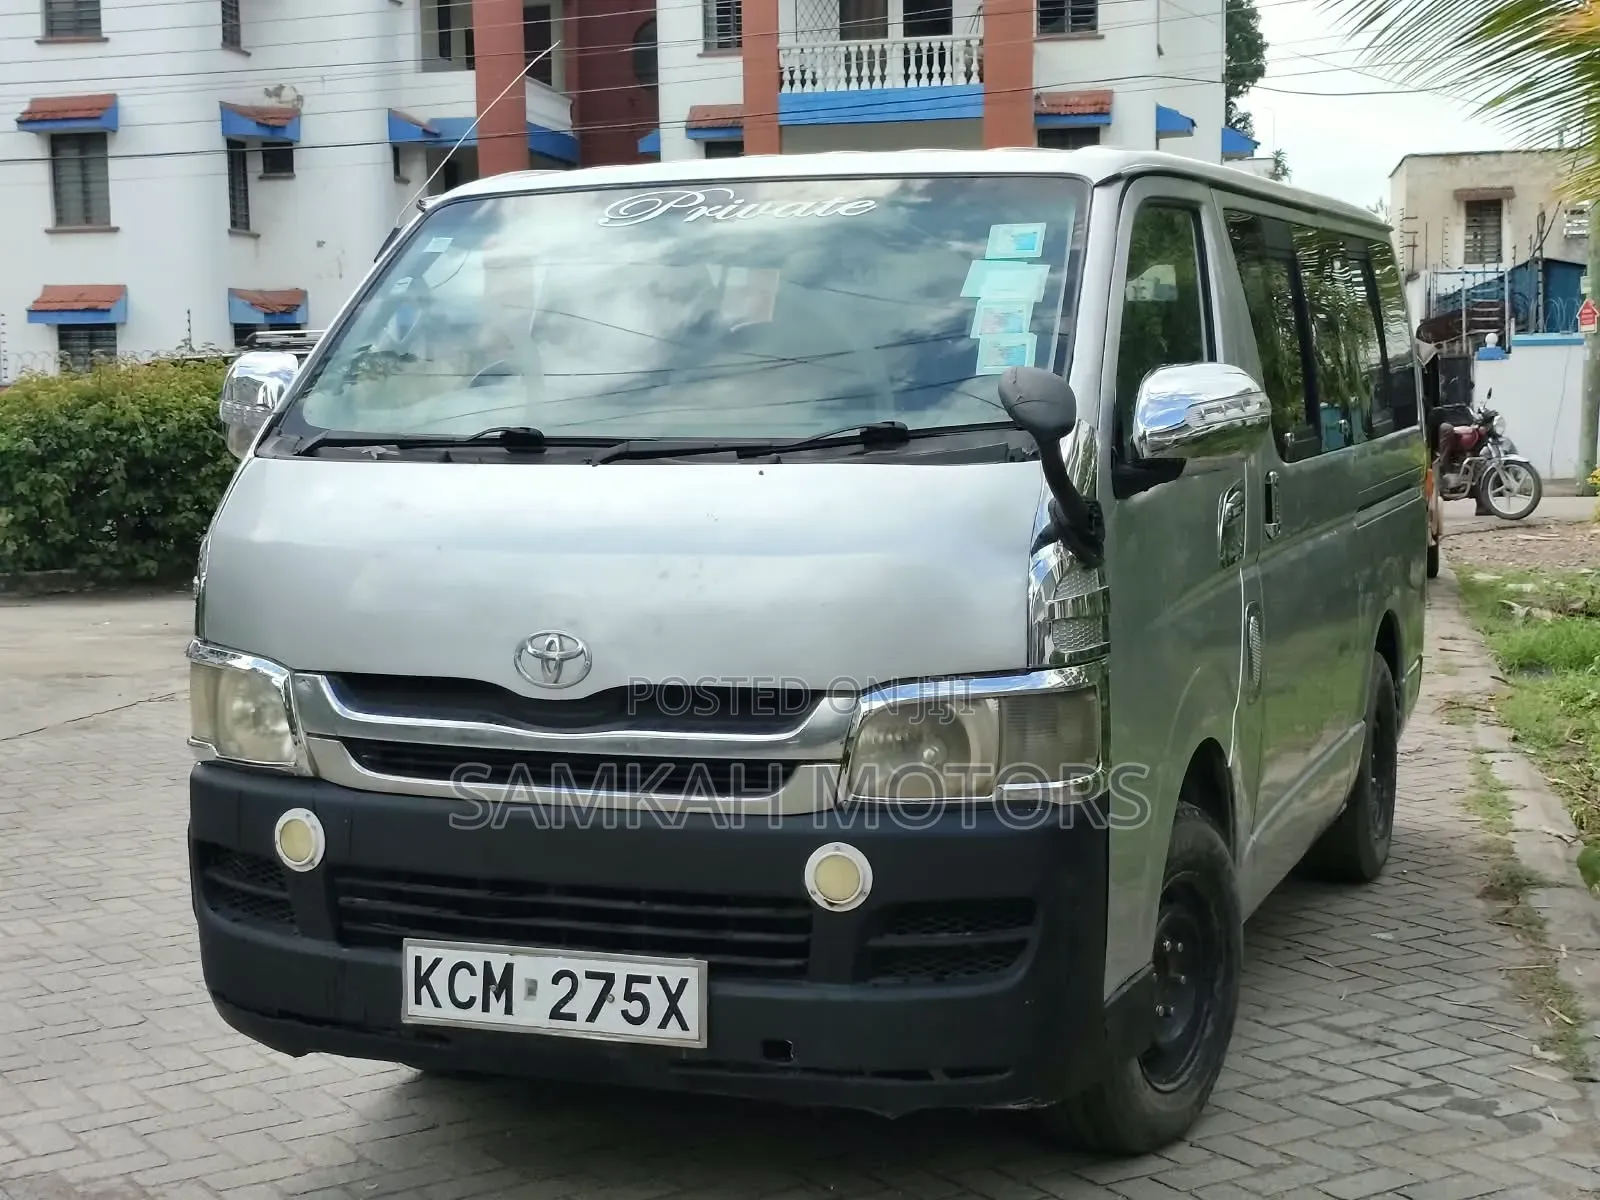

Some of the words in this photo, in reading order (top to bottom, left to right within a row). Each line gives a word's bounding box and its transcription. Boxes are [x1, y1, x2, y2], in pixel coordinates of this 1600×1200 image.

[598, 188, 877, 227] Private
[414, 955, 514, 1015] KCM
[549, 969, 690, 1031] 275X
